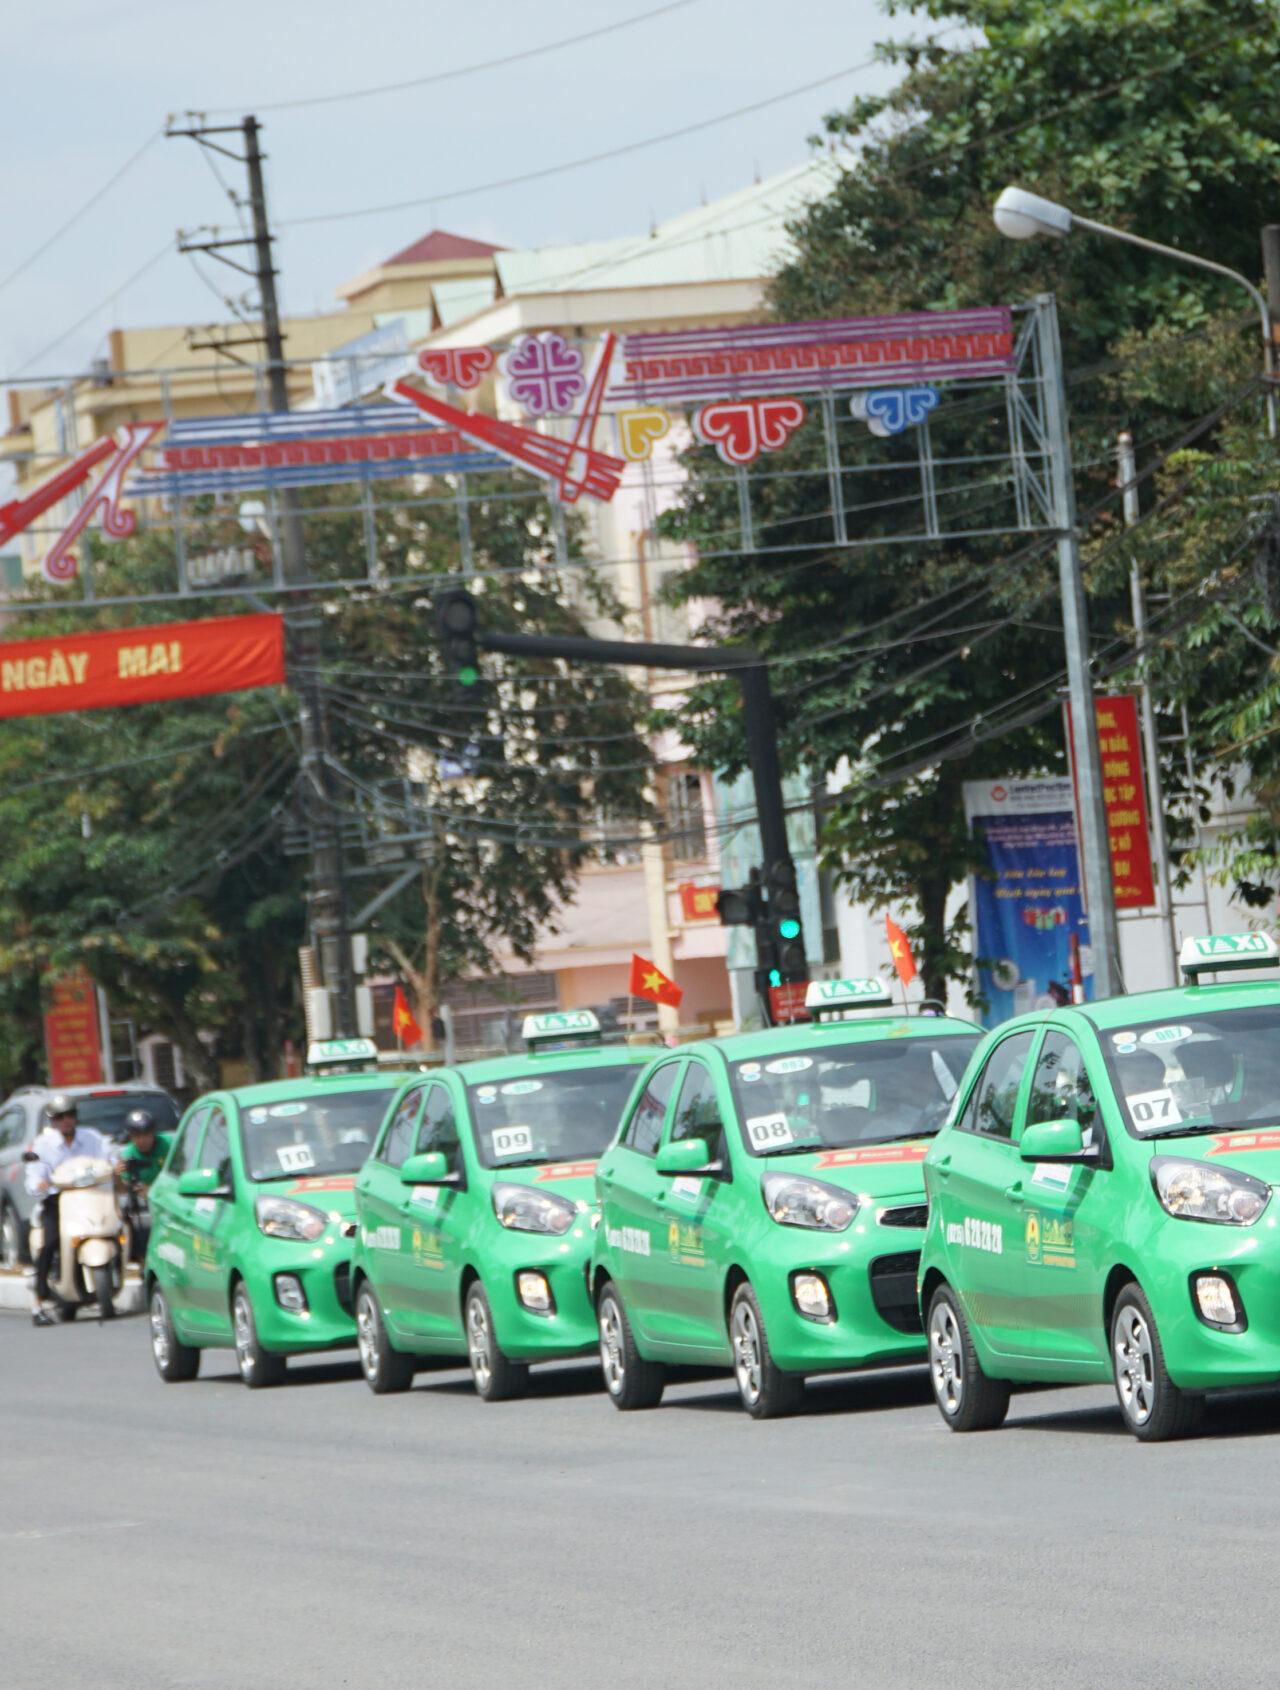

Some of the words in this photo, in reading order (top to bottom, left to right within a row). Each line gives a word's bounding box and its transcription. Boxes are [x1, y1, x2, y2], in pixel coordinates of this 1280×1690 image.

[2, 650, 88, 692] NGÀY
[117, 641, 182, 679] MAI
[1132, 1097, 1172, 1121] 07
[496, 1132, 528, 1150] 09
[752, 1122, 787, 1142] 08
[283, 1150, 309, 1166] 10
